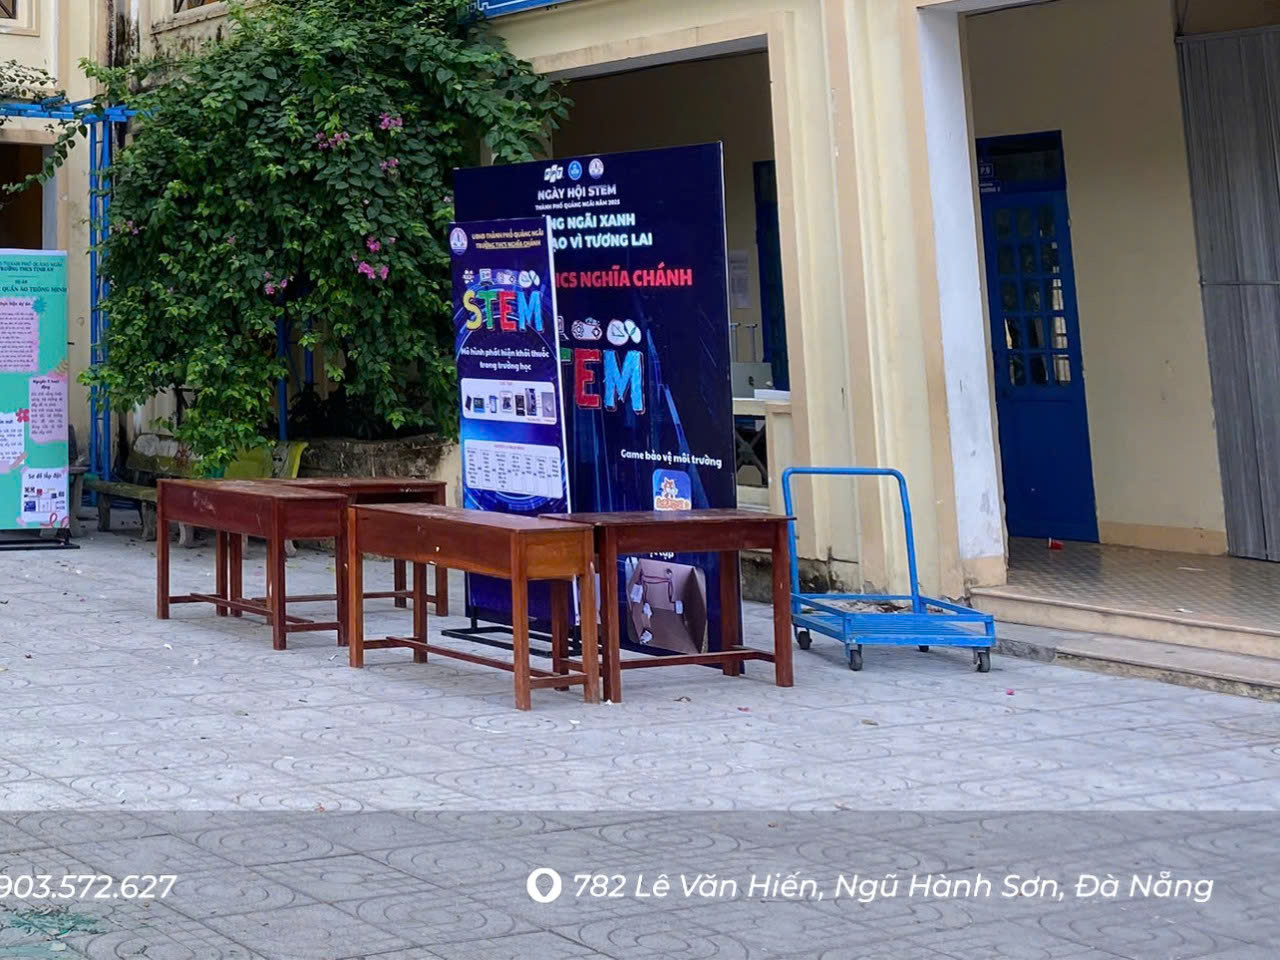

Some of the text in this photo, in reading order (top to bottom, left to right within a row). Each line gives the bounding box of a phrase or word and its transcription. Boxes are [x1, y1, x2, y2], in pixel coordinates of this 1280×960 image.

[538, 184, 617, 200] NGÀY HỘI STEM
[567, 213, 597, 229] NGÃI
[600, 213, 635, 227] XANH
[570, 235, 582, 249] VÌ
[585, 232, 628, 248] TƯƠNG
[632, 233, 653, 246] LAI
[580, 265, 630, 287] NGHĨA
[633, 261, 693, 287] CHÁNH
[463, 290, 544, 332] STEM
[480, 361, 531, 372] trong trường học
[559, 347, 646, 415] EM
[620, 449, 722, 469] Game bảo vệ môi trường
